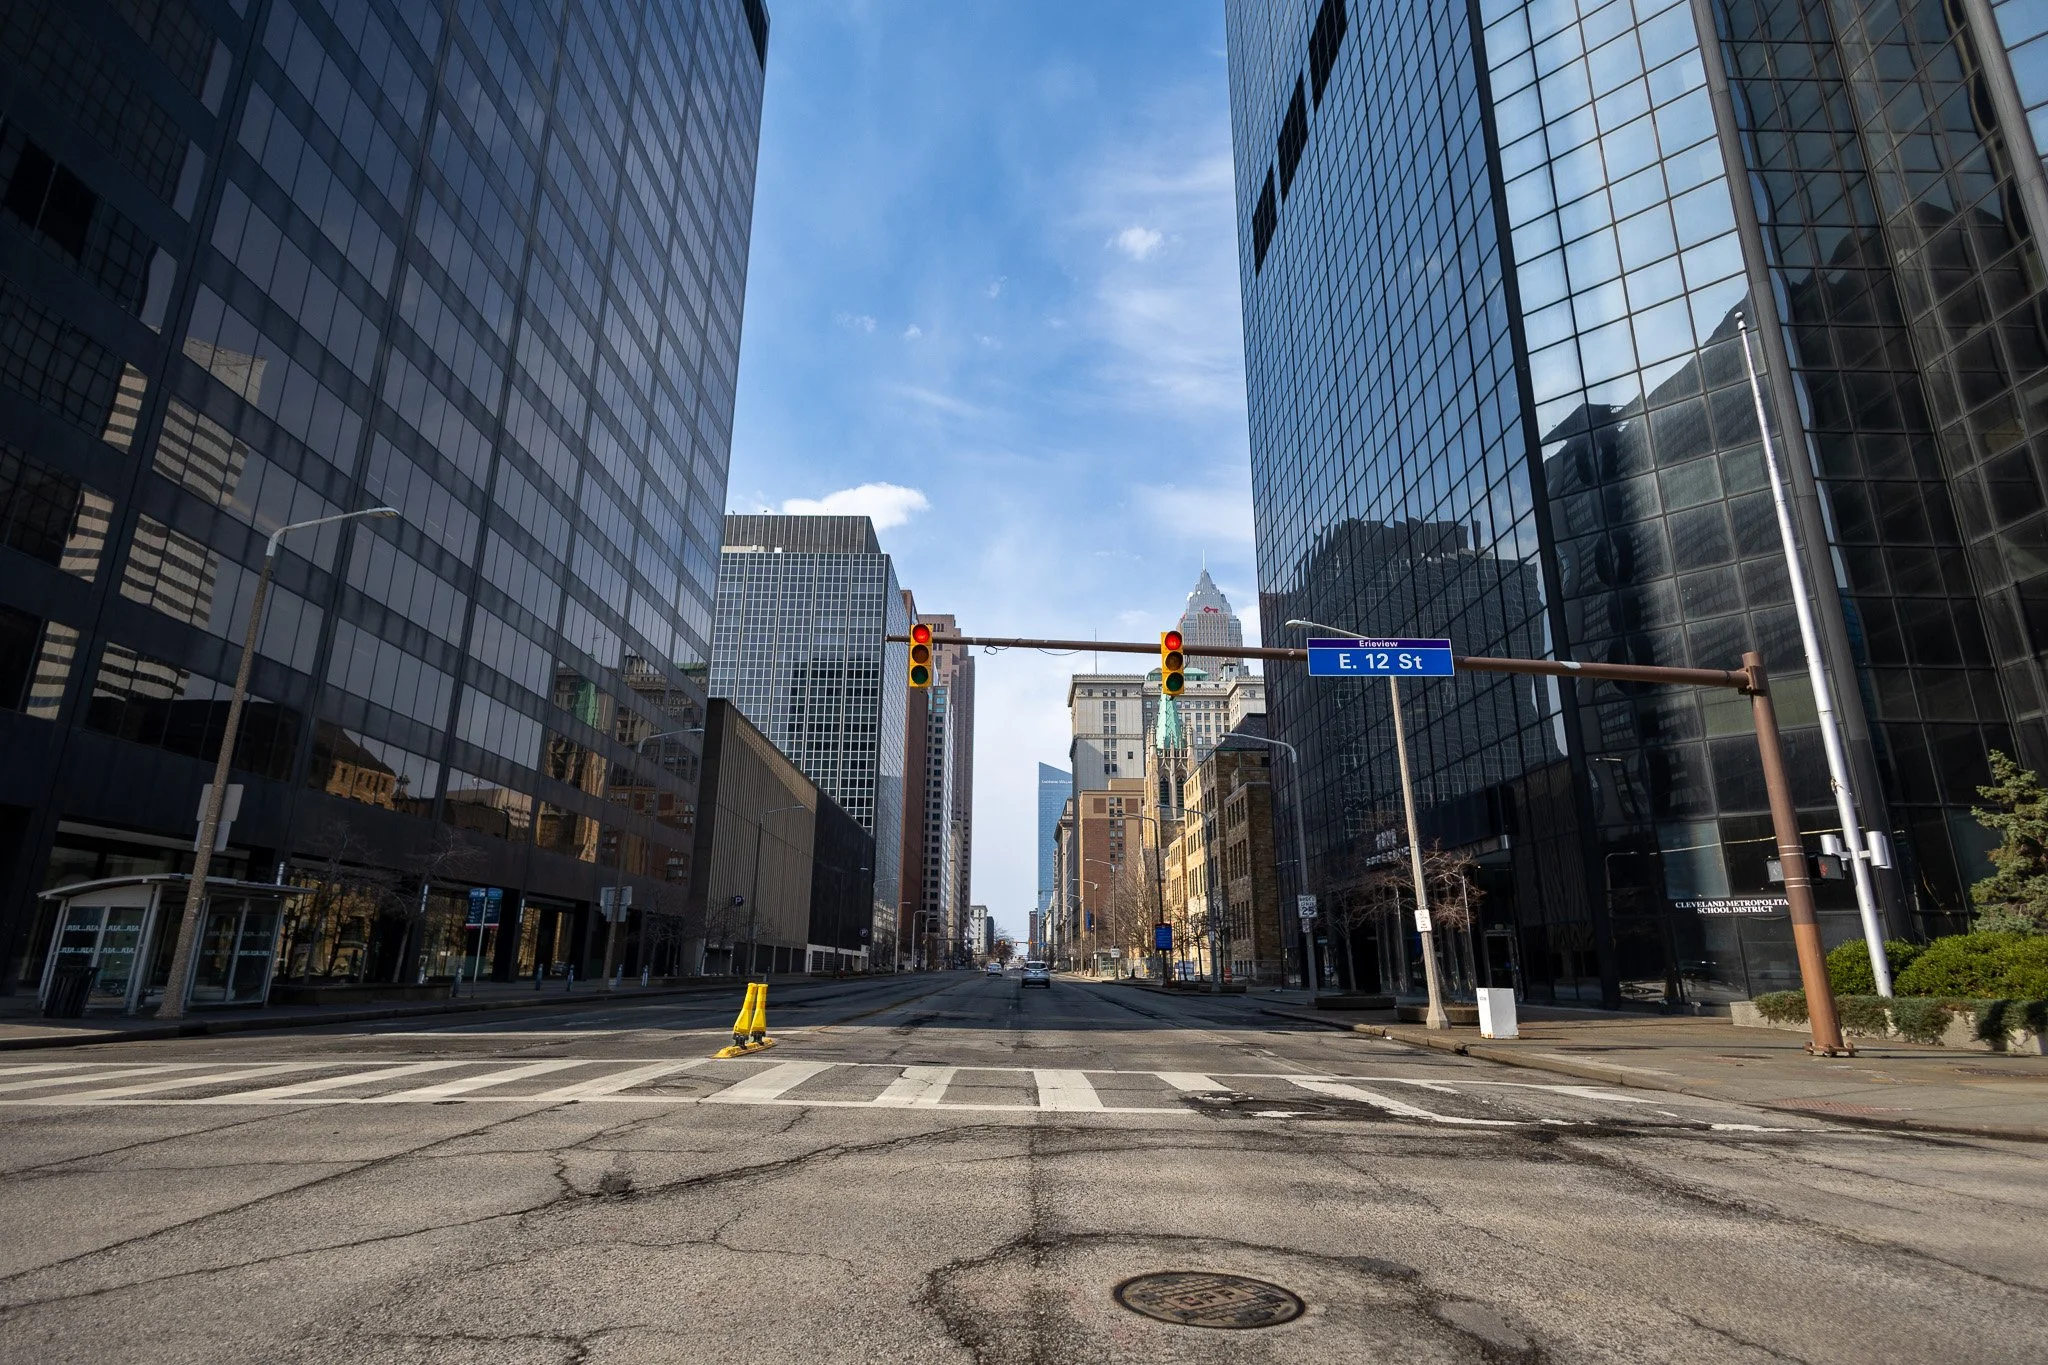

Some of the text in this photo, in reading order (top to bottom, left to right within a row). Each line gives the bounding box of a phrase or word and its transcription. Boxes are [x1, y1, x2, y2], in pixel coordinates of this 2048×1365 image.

[1339, 653, 1423, 670] E. 12 St
[1675, 899, 1789, 909] CLEVELAND METROPOLITA
[1302, 906, 1315, 915] 25
[1697, 905, 1773, 914] SCHOOL DISTRICT
